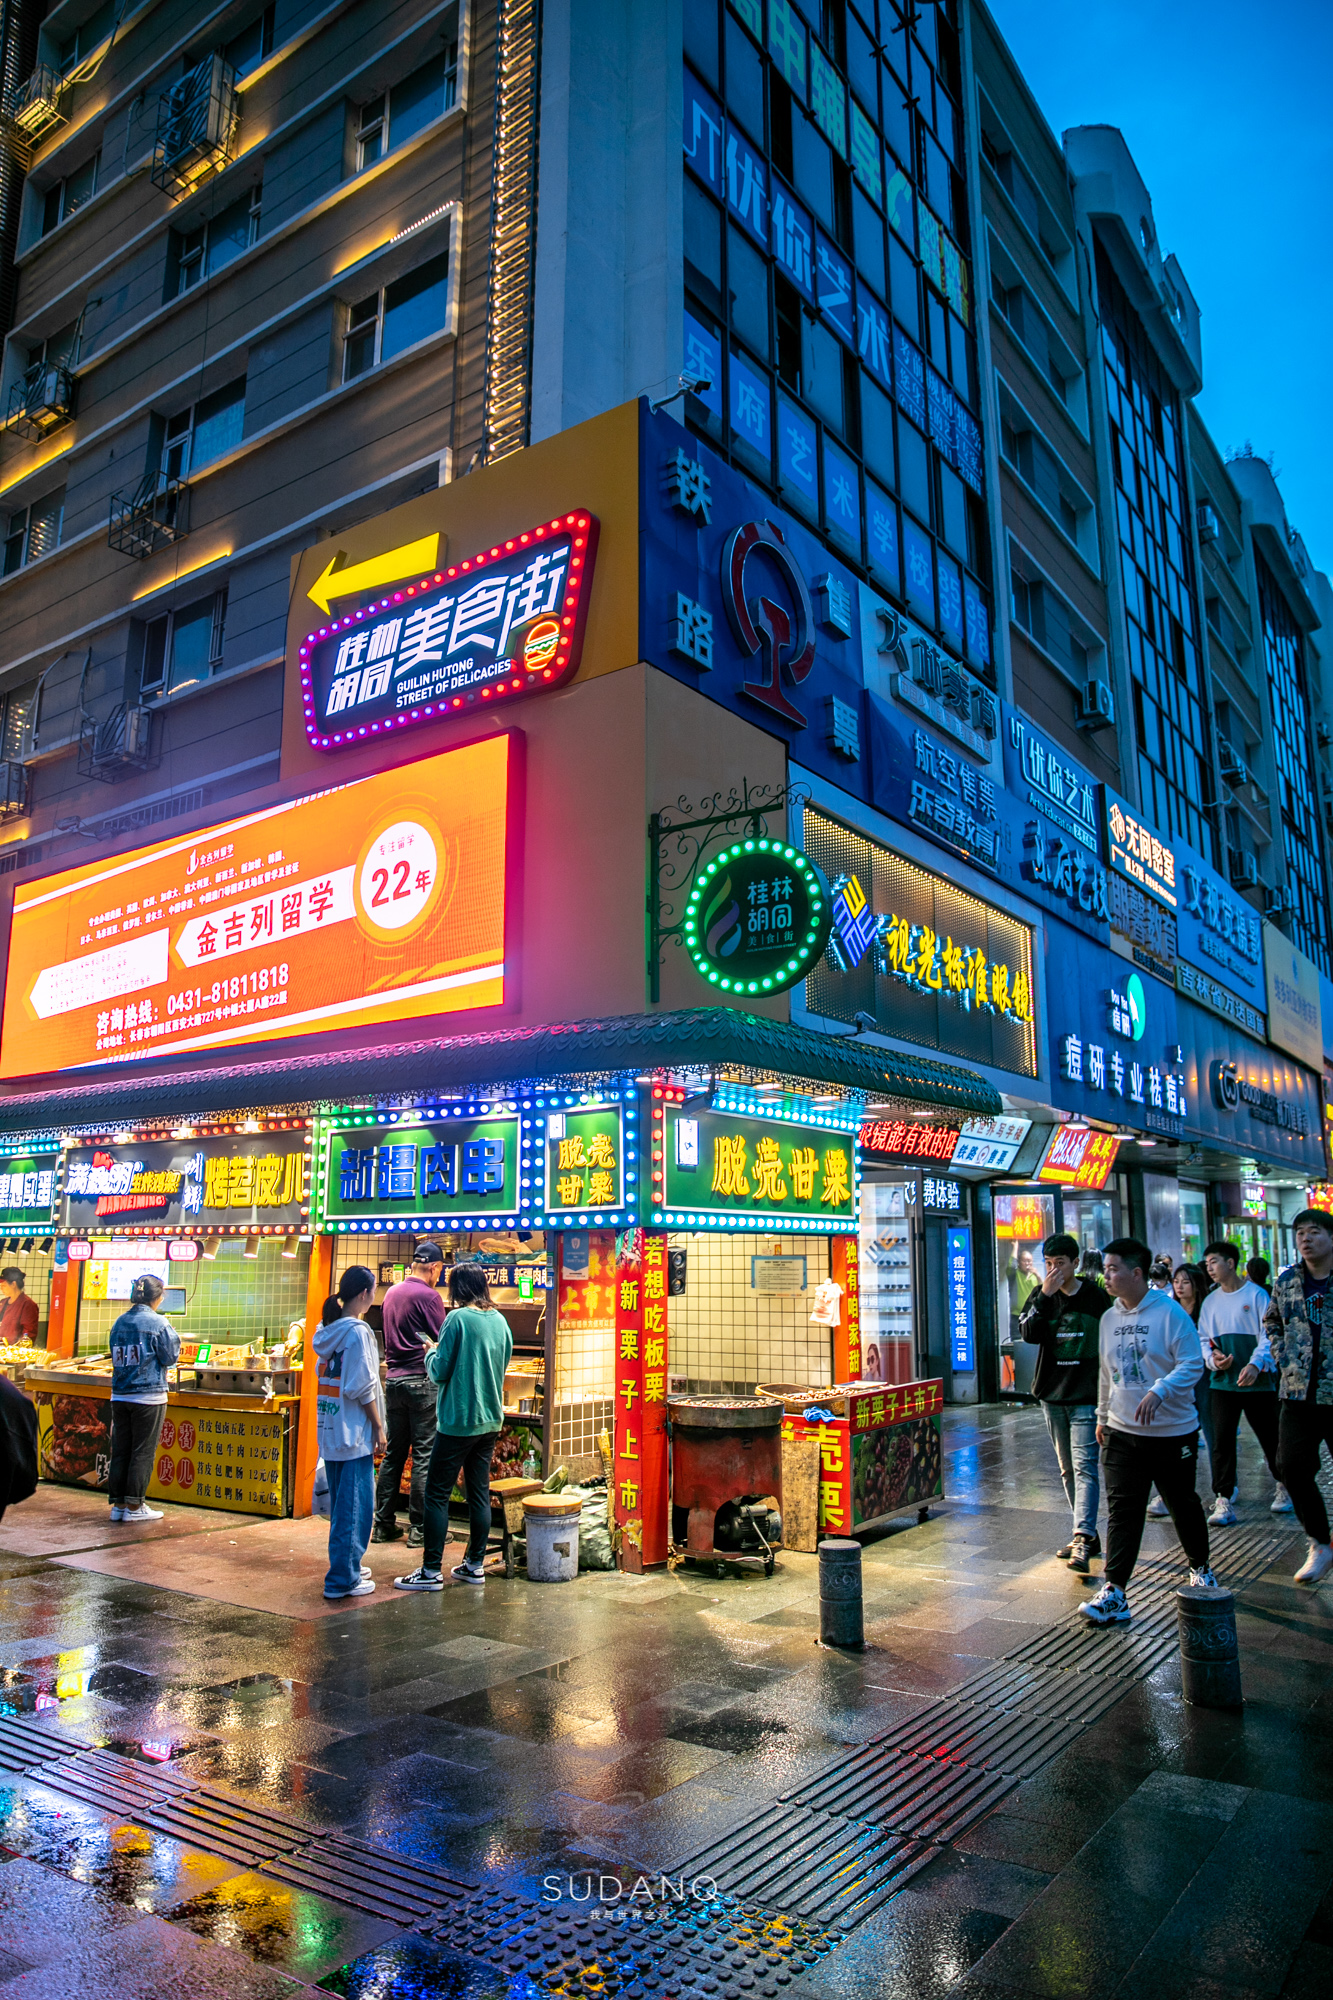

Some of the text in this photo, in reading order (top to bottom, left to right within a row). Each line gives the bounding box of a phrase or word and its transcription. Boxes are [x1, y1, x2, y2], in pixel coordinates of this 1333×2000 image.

[668, 447, 714, 672] 铁路
[394, 546, 569, 679] 美食街
[334, 617, 402, 675] 桂林
[819, 572, 860, 762] 售票
[326, 655, 394, 717] 胡同
[396, 659, 511, 707] STREET OF DELICACIES
[397, 658, 473, 693] GUILIN HUTONG
[914, 729, 996, 820] 航空售票
[1029, 737, 1096, 827] 优你艺术
[379, 834, 415, 856] 专注留学
[907, 780, 996, 858] 乐奇教育
[1126, 815, 1175, 887] 无间密室
[371, 860, 432, 908] 22年
[747, 876, 793, 905] 桂林
[197, 880, 334, 958] 金吉列留学
[748, 904, 792, 932] 胡同
[167, 963, 289, 1016] 0431-81811818
[887, 913, 1033, 1022] 视光标准眼镜
[1180, 965, 1265, 1036] 吉林省万达国旅
[1066, 1034, 1178, 1115] 痘研专业祛痘
[339, 1138, 504, 1200] 新疆肉串
[558, 1133, 616, 1170] 脱壳
[712, 1135, 852, 1207] 脱壳甘栗
[956, 1144, 1009, 1166] 铁路 售票
[1077, 1161, 1108, 1187] 排骨串
[1088, 1135, 1114, 1160] 麻辣
[556, 1171, 616, 1206] 甘栗
[643, 1236, 666, 1404] 若想吃板栗
[845, 1241, 860, 1374] 独有咱家甜
[619, 1279, 639, 1511] 新栗子上市
[856, 1385, 938, 1430] 新栗子上市了
[249, 1447, 280, 1461] 12元/份
[250, 1425, 280, 1439] 12元/份
[159, 1457, 194, 1485] 皮儿
[248, 1469, 279, 1484] 12元/份
[248, 1492, 278, 1506] 12元/份
